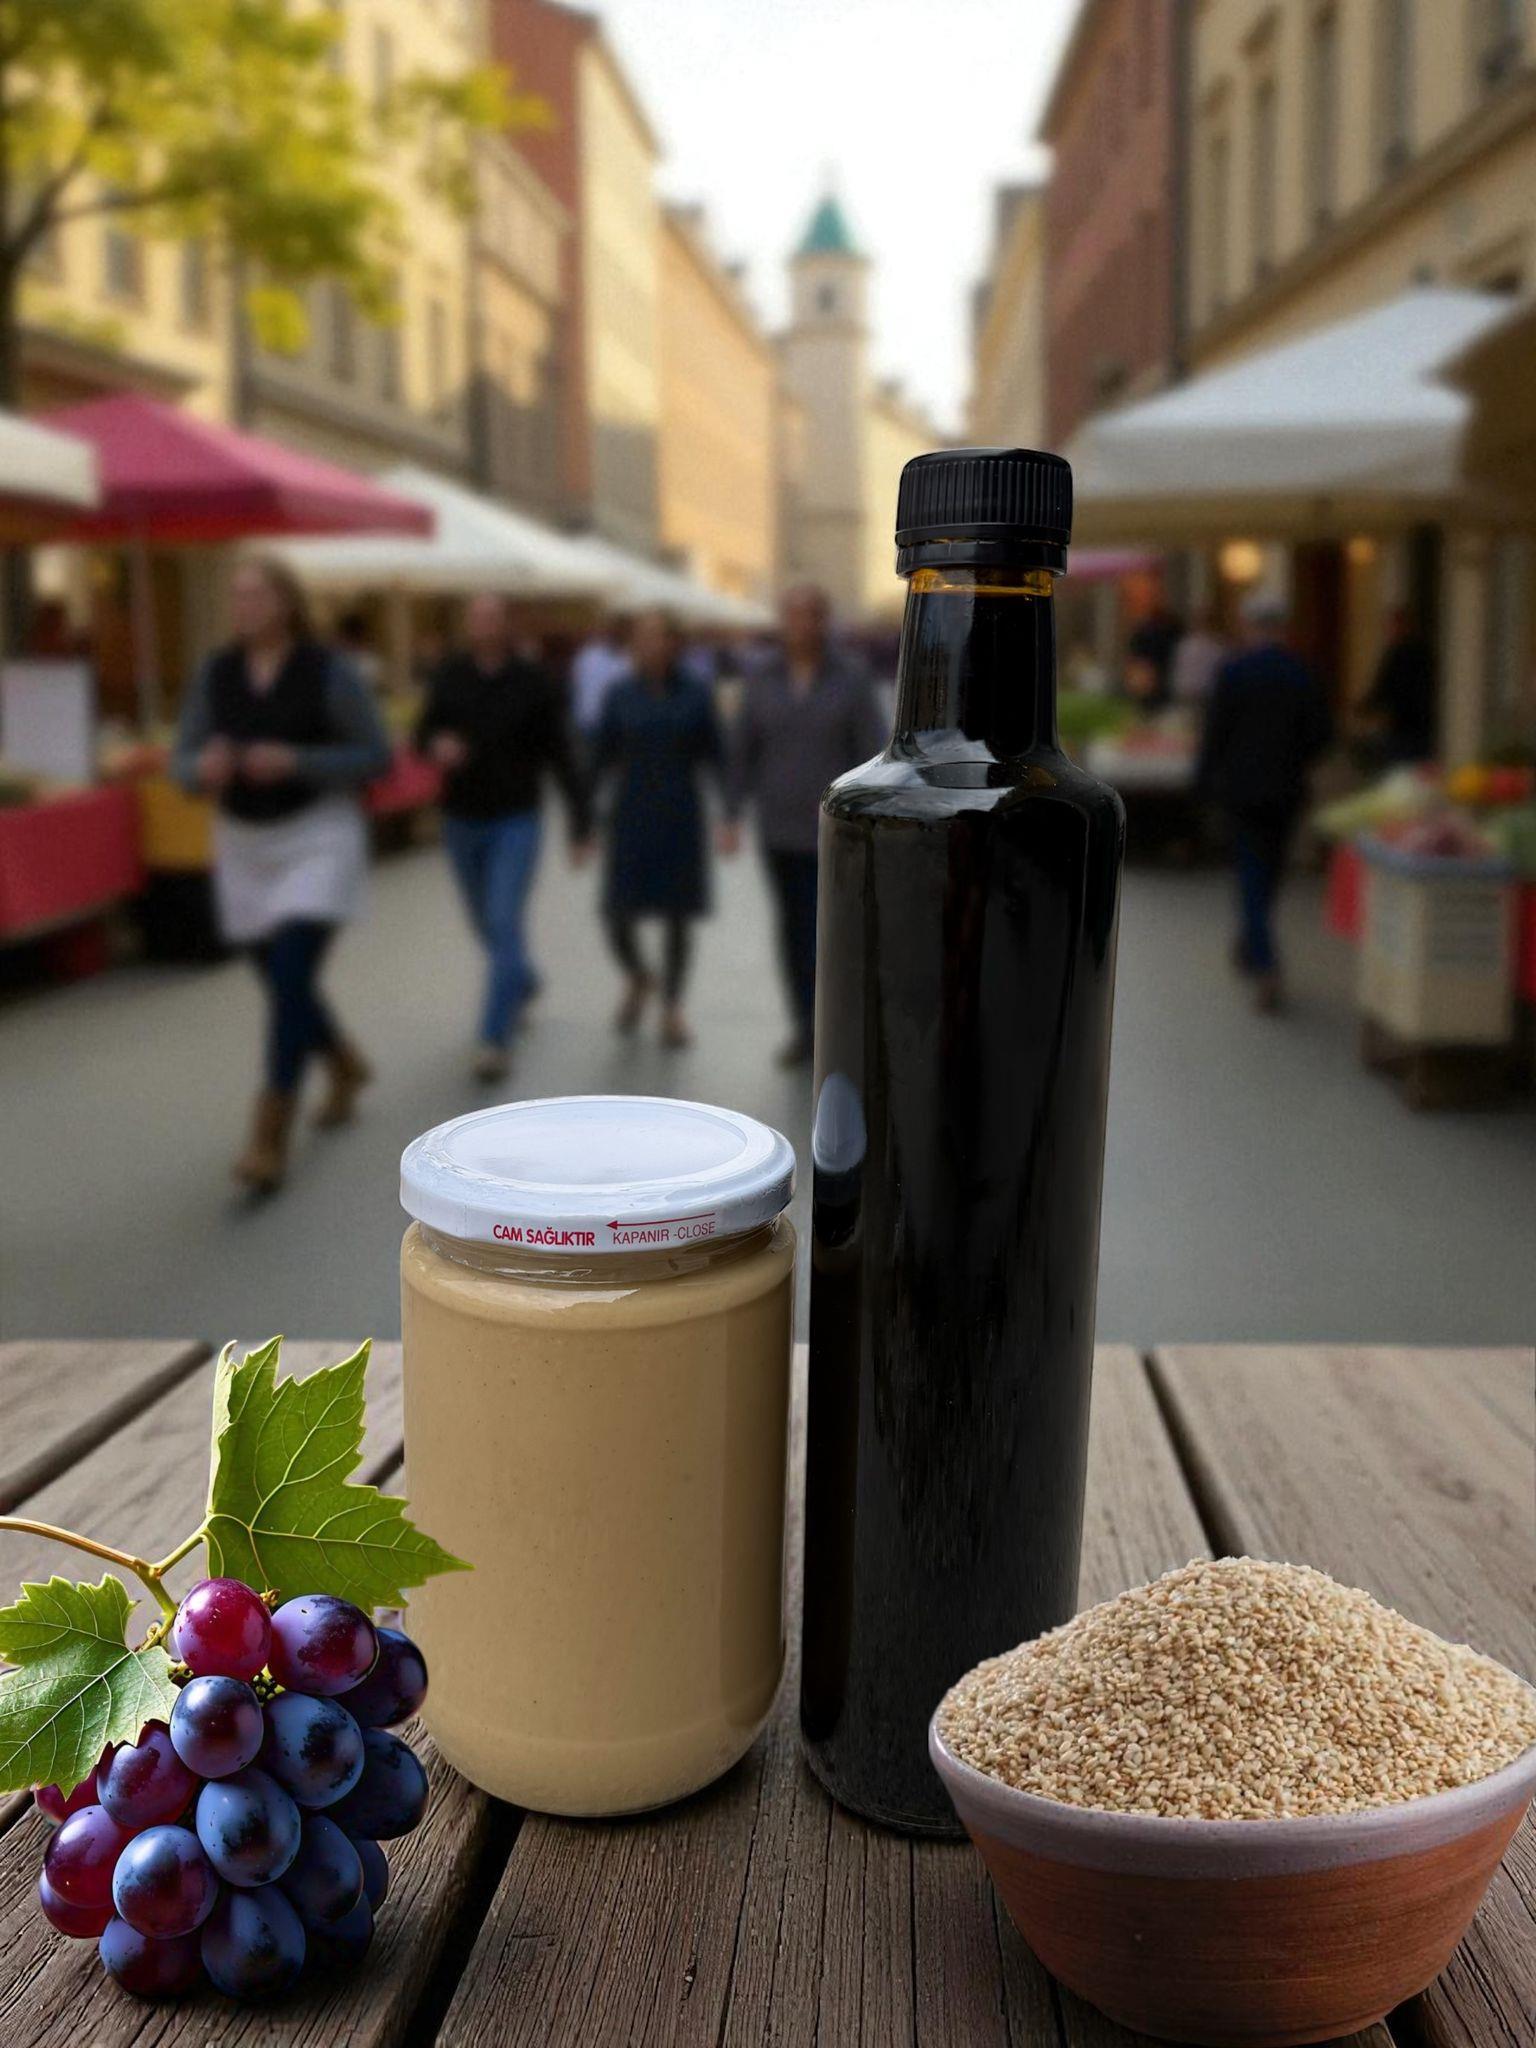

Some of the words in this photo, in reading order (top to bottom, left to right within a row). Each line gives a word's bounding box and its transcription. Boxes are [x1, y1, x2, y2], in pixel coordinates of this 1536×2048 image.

[493, 1224, 523, 1242] CAM
[526, 1226, 596, 1246] SAĞLIKTIR
[613, 1228, 670, 1245] KAPANIR
